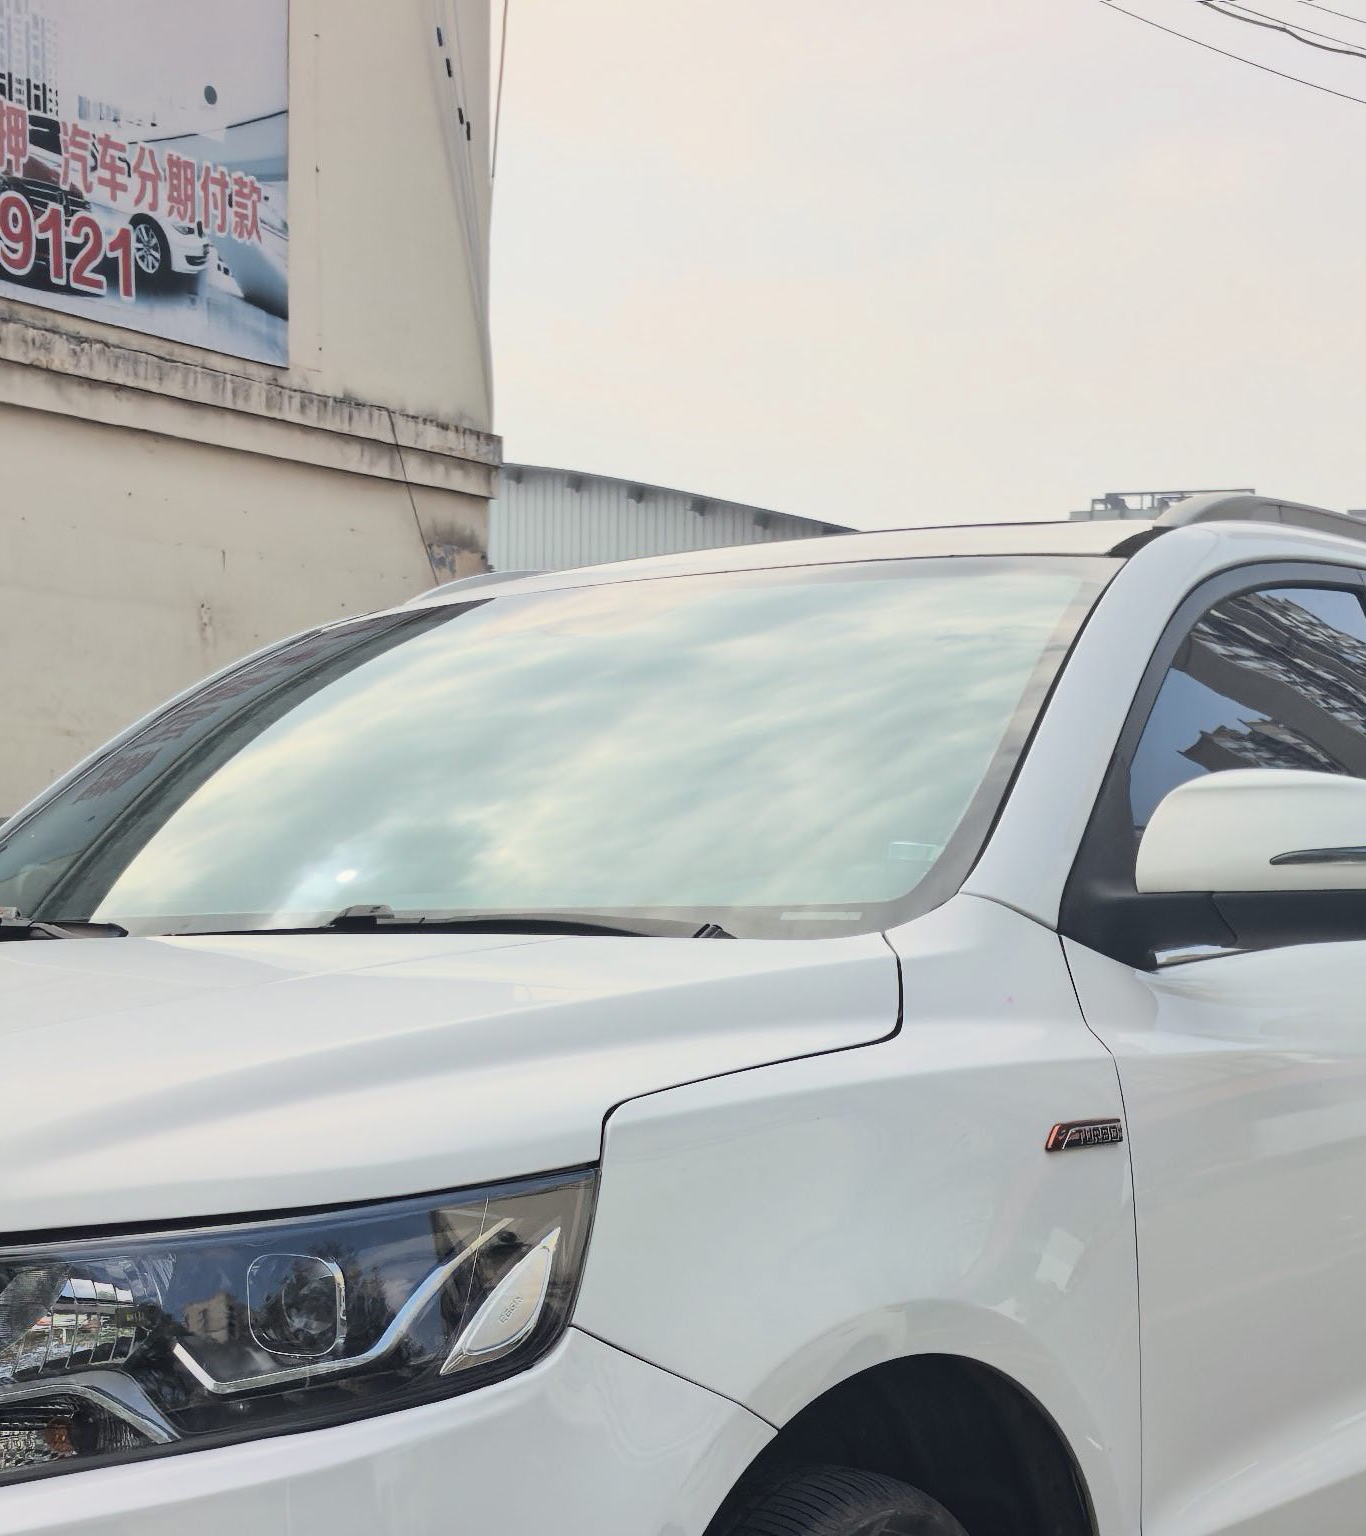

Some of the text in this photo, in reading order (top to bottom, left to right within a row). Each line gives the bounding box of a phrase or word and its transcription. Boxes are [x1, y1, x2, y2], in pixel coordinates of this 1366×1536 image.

[60, 123, 263, 243] 汽车分期付款
